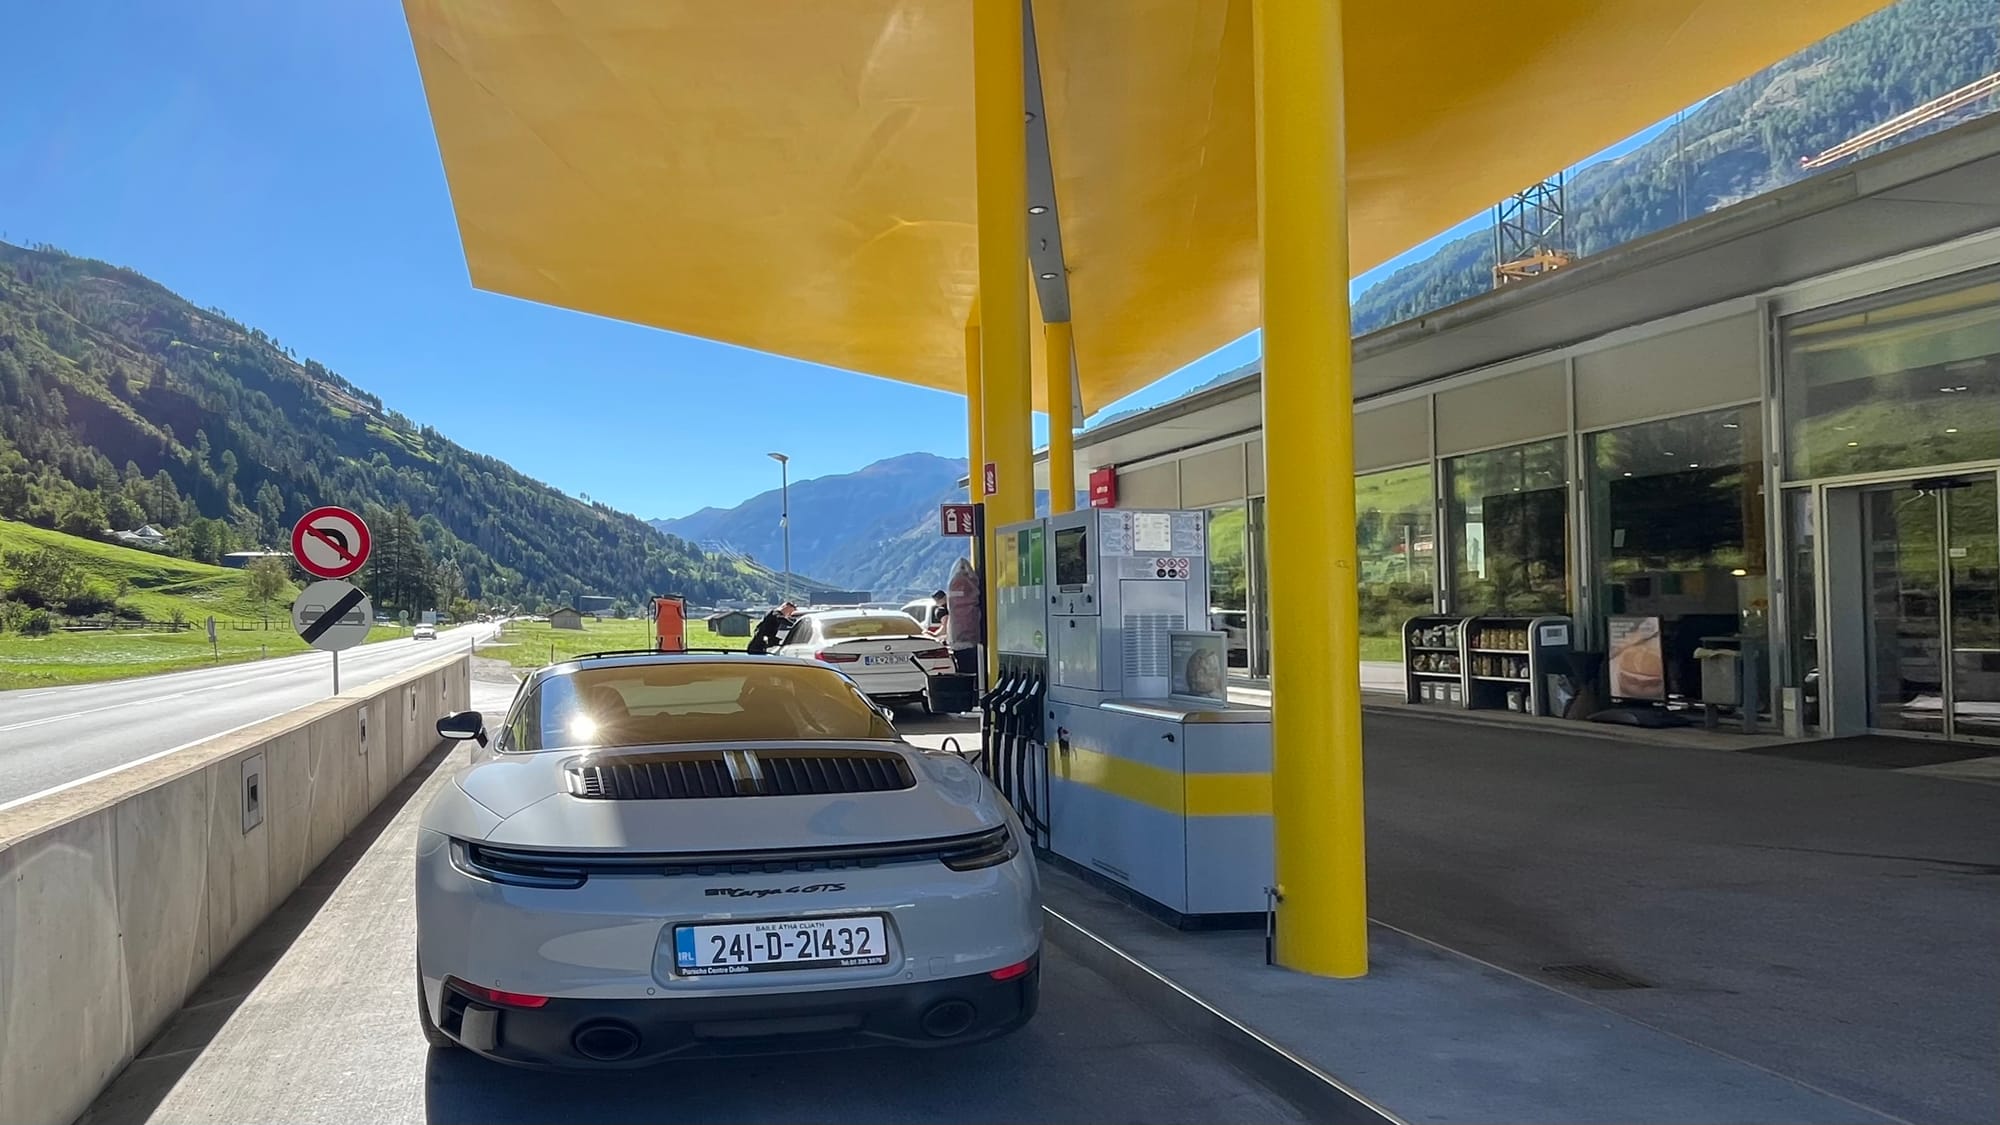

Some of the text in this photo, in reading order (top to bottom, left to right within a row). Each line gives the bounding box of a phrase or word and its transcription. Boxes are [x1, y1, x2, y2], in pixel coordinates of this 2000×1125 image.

[801, 883, 847, 894] GTS
[755, 924, 777, 932] BAILE
[799, 921, 825, 930] CLIATH
[710, 926, 872, 964] 241-D-21432
[678, 951, 695, 961] IRL
[681, 965, 750, 976] Porsche Centre Dublin
